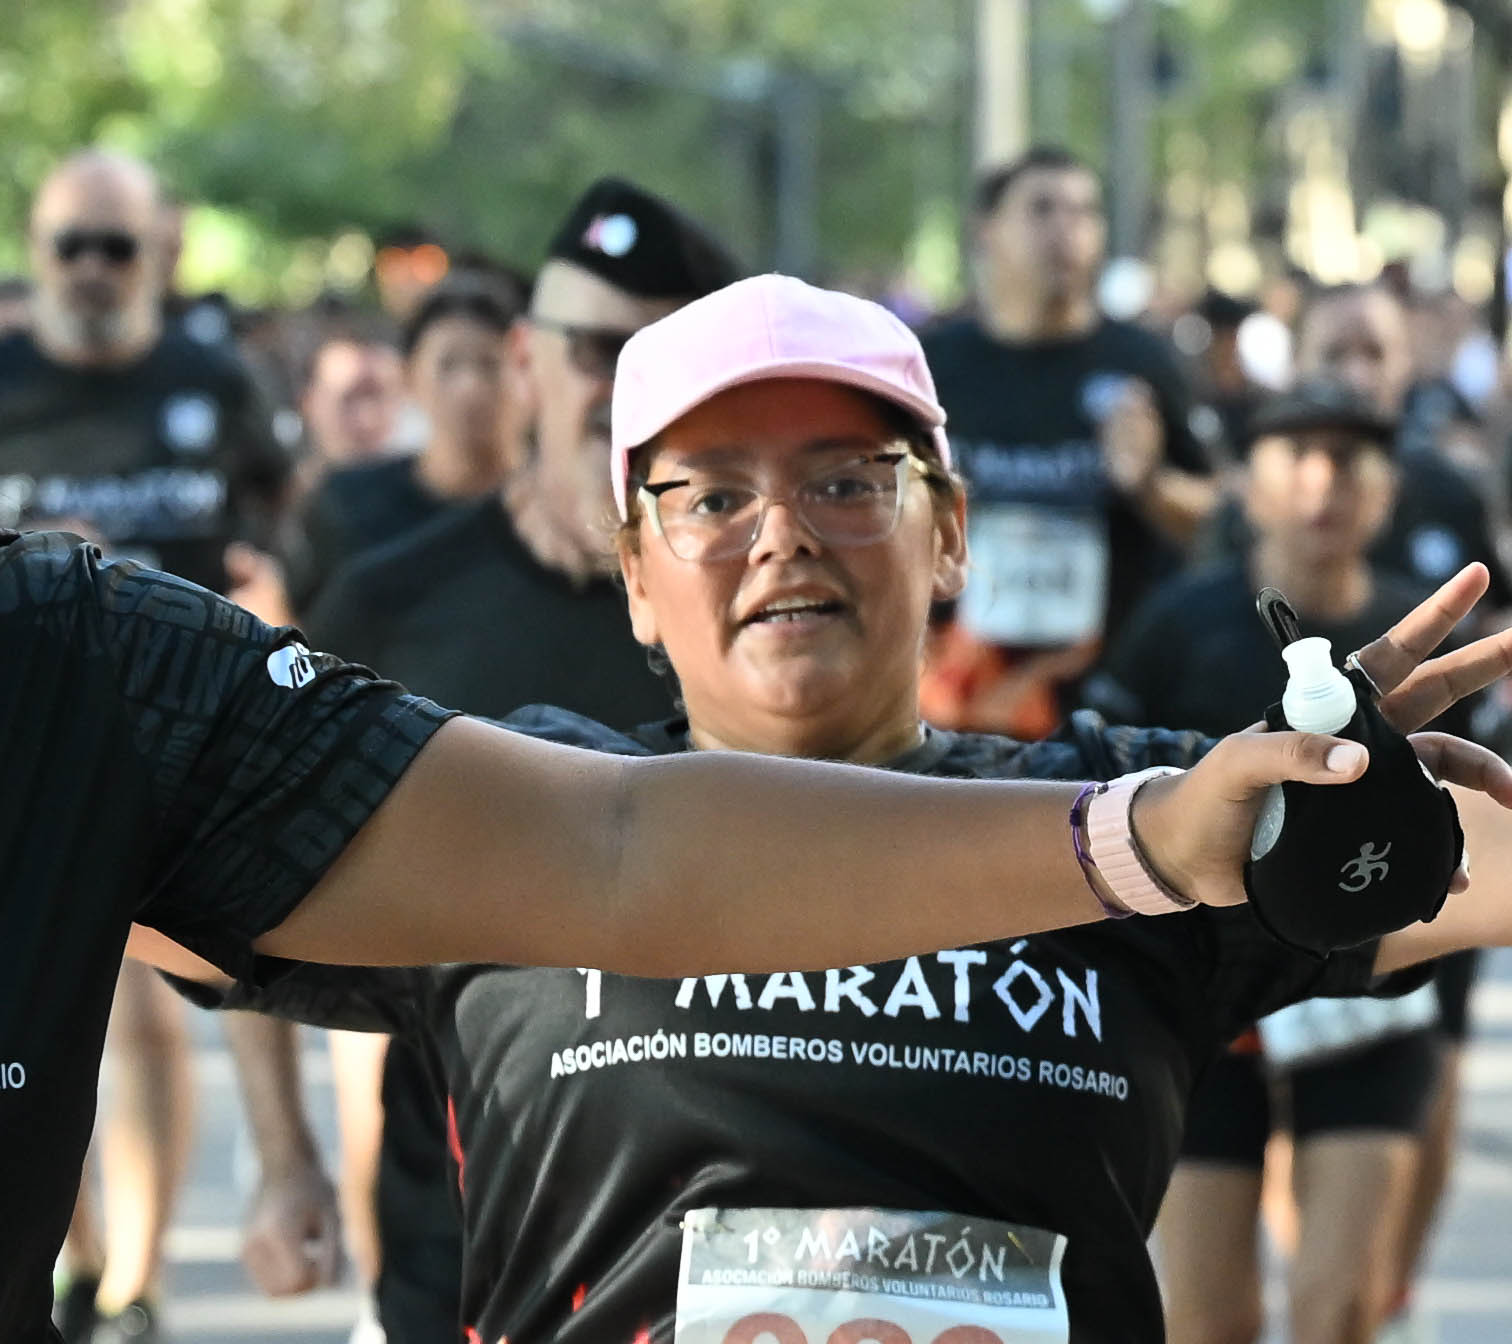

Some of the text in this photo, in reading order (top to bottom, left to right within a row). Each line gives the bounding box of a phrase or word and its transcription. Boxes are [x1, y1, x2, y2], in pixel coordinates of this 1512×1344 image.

[674, 940, 1103, 1043] MARATÓN
[550, 1028, 1130, 1101] ASOCIACIÓN BOMBEROS VOLUNTARIOS ROSARIO
[794, 1225, 1007, 1283] MARATÓN
[882, 1278, 981, 1304] VOLUNTARIOS
